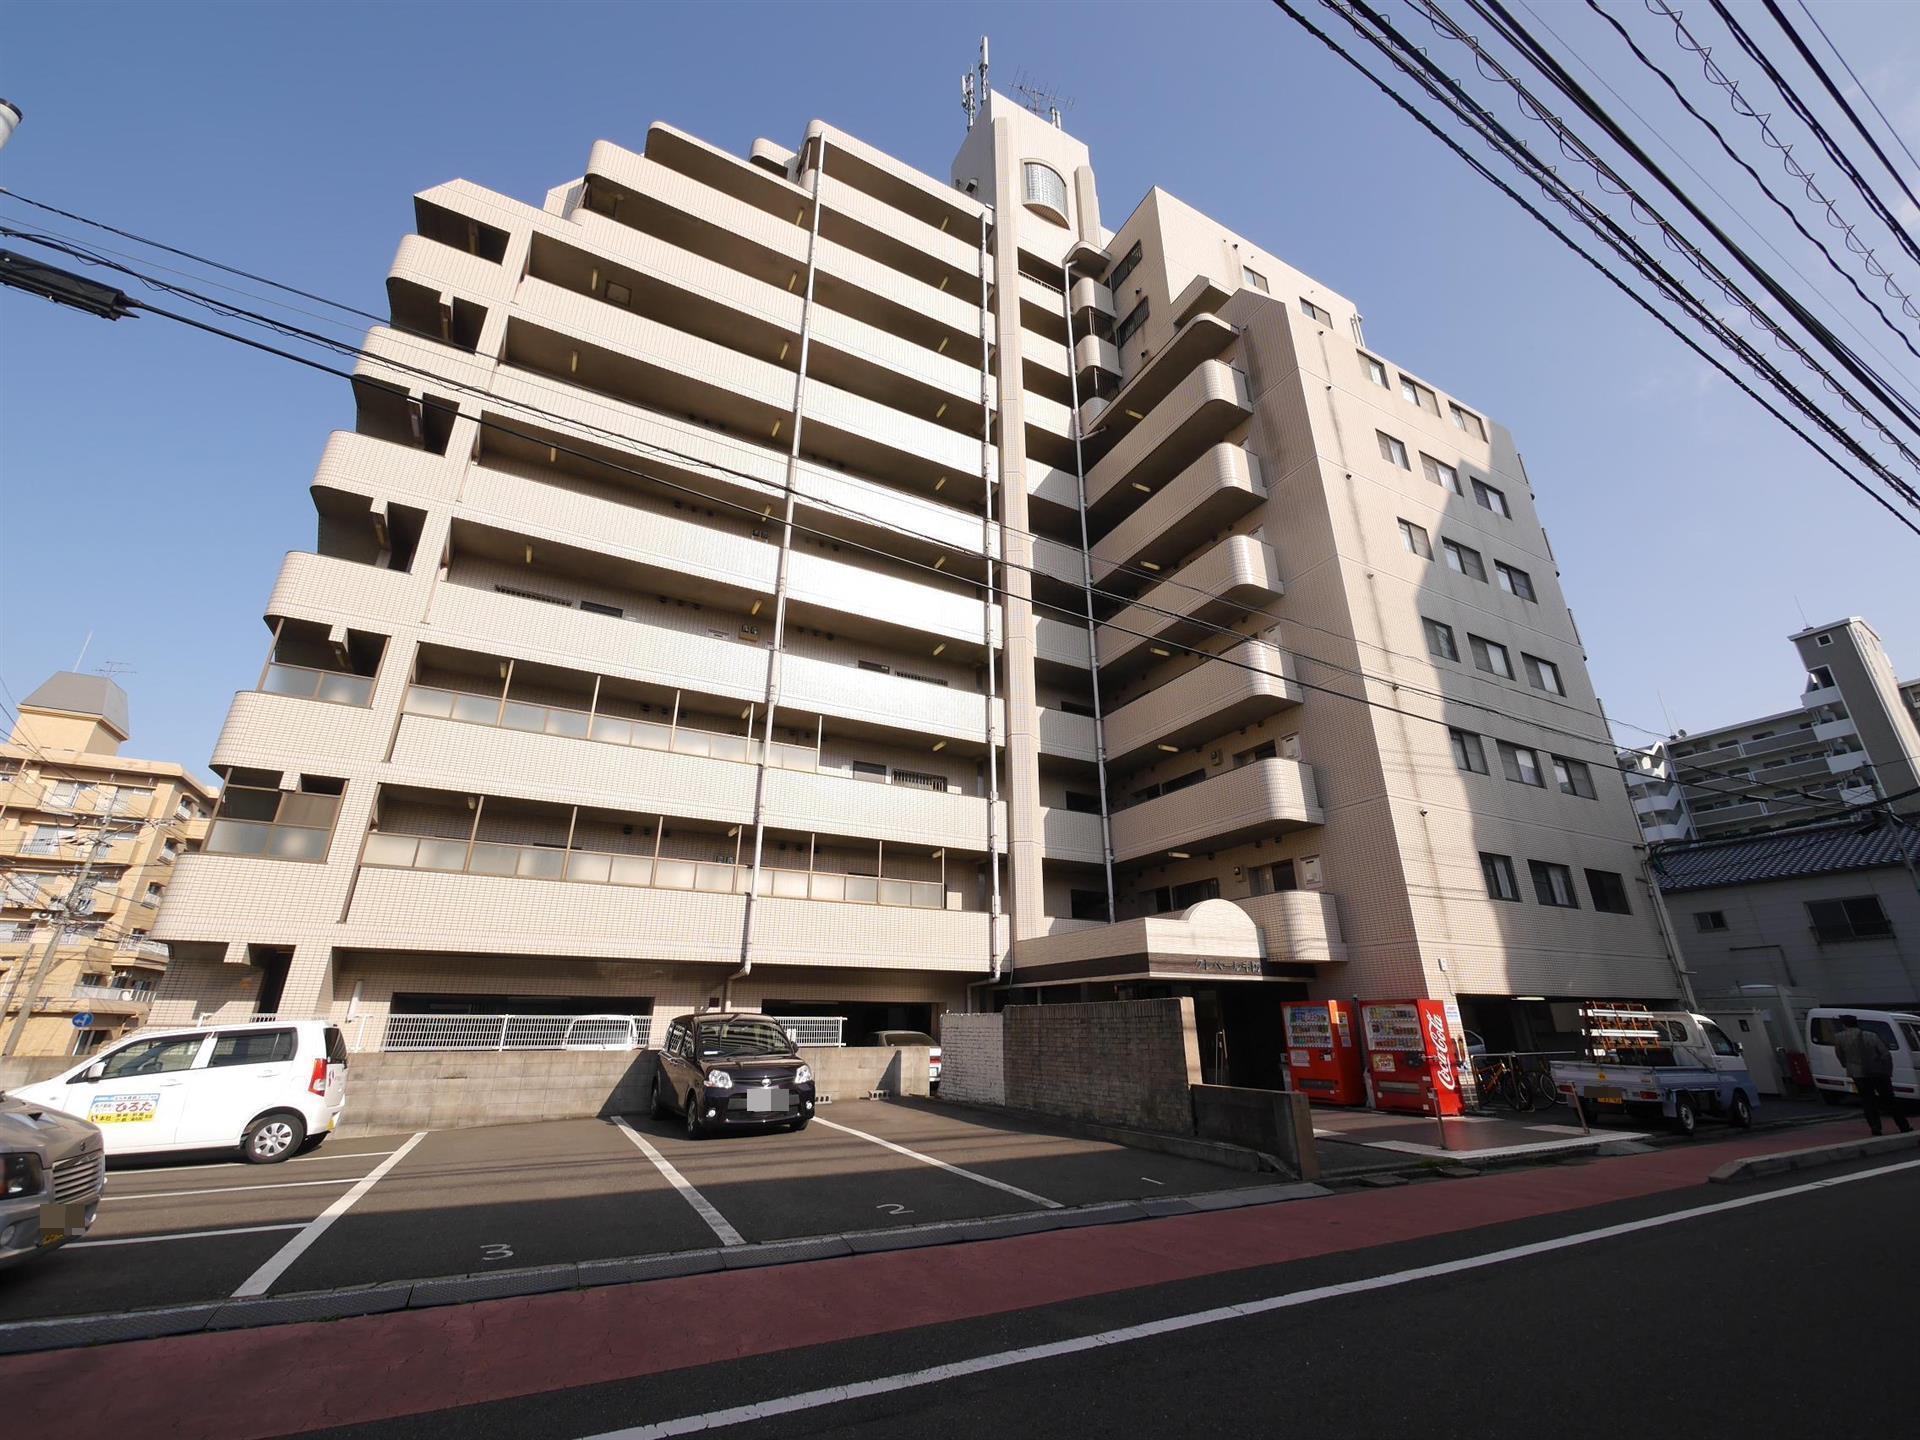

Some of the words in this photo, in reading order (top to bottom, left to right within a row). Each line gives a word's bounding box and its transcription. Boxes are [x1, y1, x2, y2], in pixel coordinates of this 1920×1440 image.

[115, 1101, 153, 1113] ひろた
[876, 1203, 915, 1215] 2
[480, 1243, 514, 1261] 3
